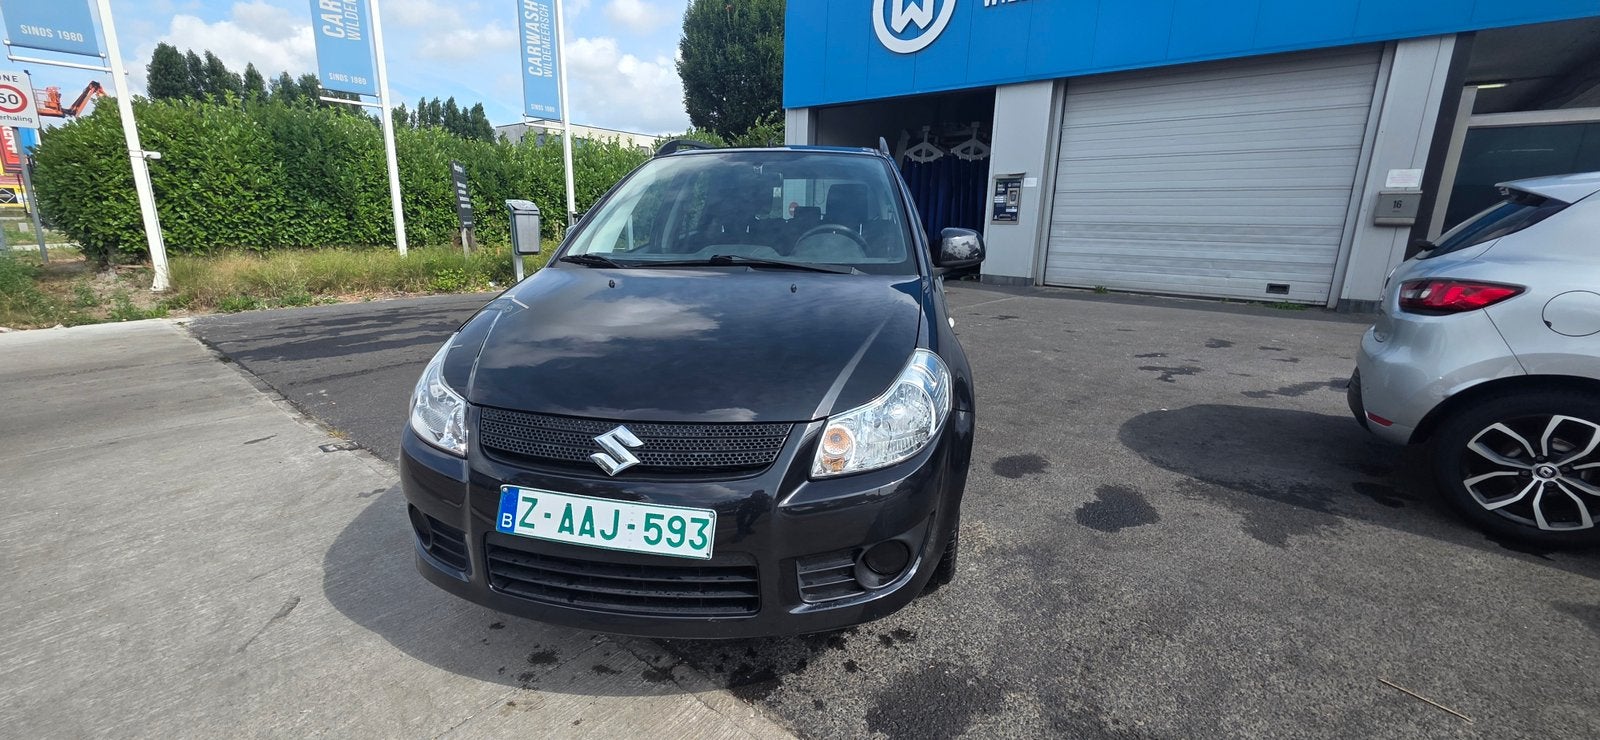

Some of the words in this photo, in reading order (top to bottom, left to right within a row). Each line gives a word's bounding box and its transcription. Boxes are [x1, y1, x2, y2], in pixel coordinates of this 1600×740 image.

[20, 24, 54, 38] SINDS
[57, 30, 84, 43] 1980
[524, 0, 542, 76] CARWASH
[0, 74, 18, 83] NE
[1393, 200, 1402, 209] 16
[501, 513, 513, 529] B
[519, 496, 710, 551] Z-AAJ-593
